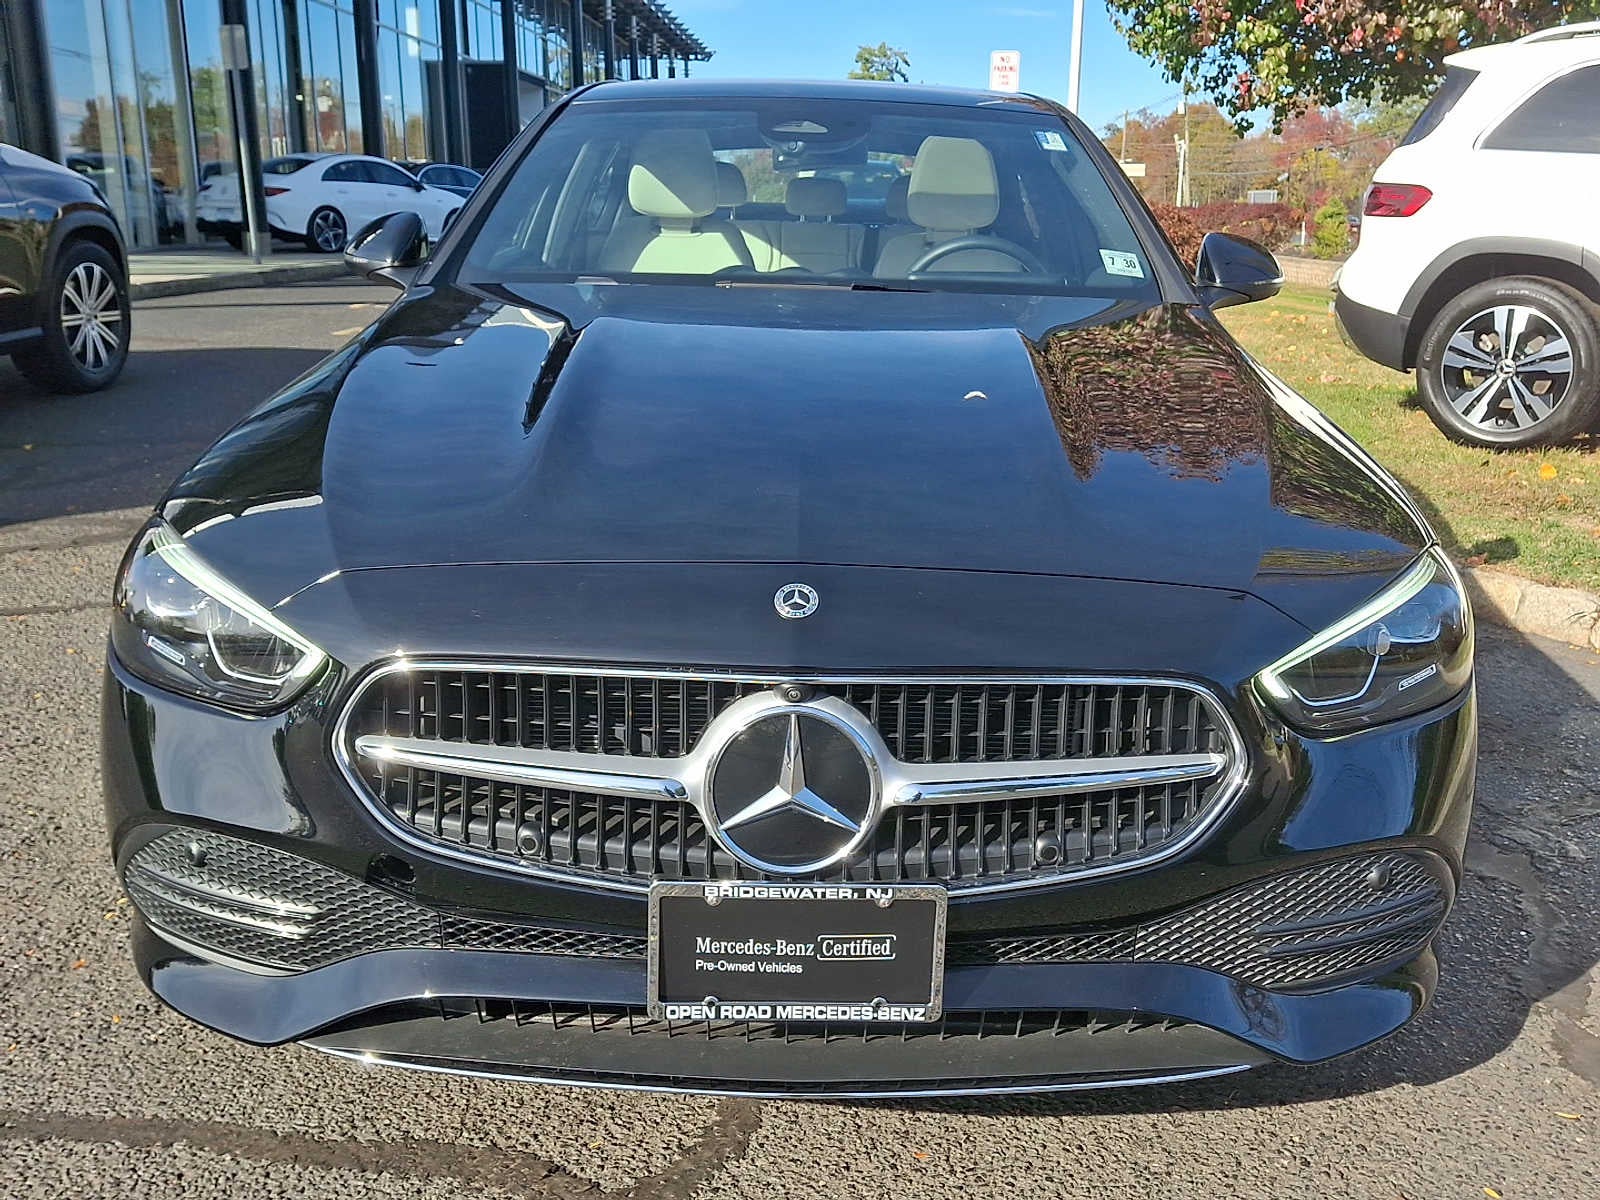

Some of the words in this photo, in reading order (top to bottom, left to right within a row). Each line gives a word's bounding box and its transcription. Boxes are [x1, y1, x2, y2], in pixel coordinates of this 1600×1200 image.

[1108, 256, 1115, 266] 7
[1123, 258, 1137, 269] 30
[704, 886, 858, 899] BRIDGEWATER,
[866, 888, 893, 899] NJ
[696, 937, 814, 956] Mercedes-Benz
[823, 939, 891, 956] Certified
[695, 959, 755, 973] Pre-Owned
[757, 961, 803, 974] Vehicles
[666, 1005, 716, 1019] OPEN
[720, 1005, 771, 1019] ROAD
